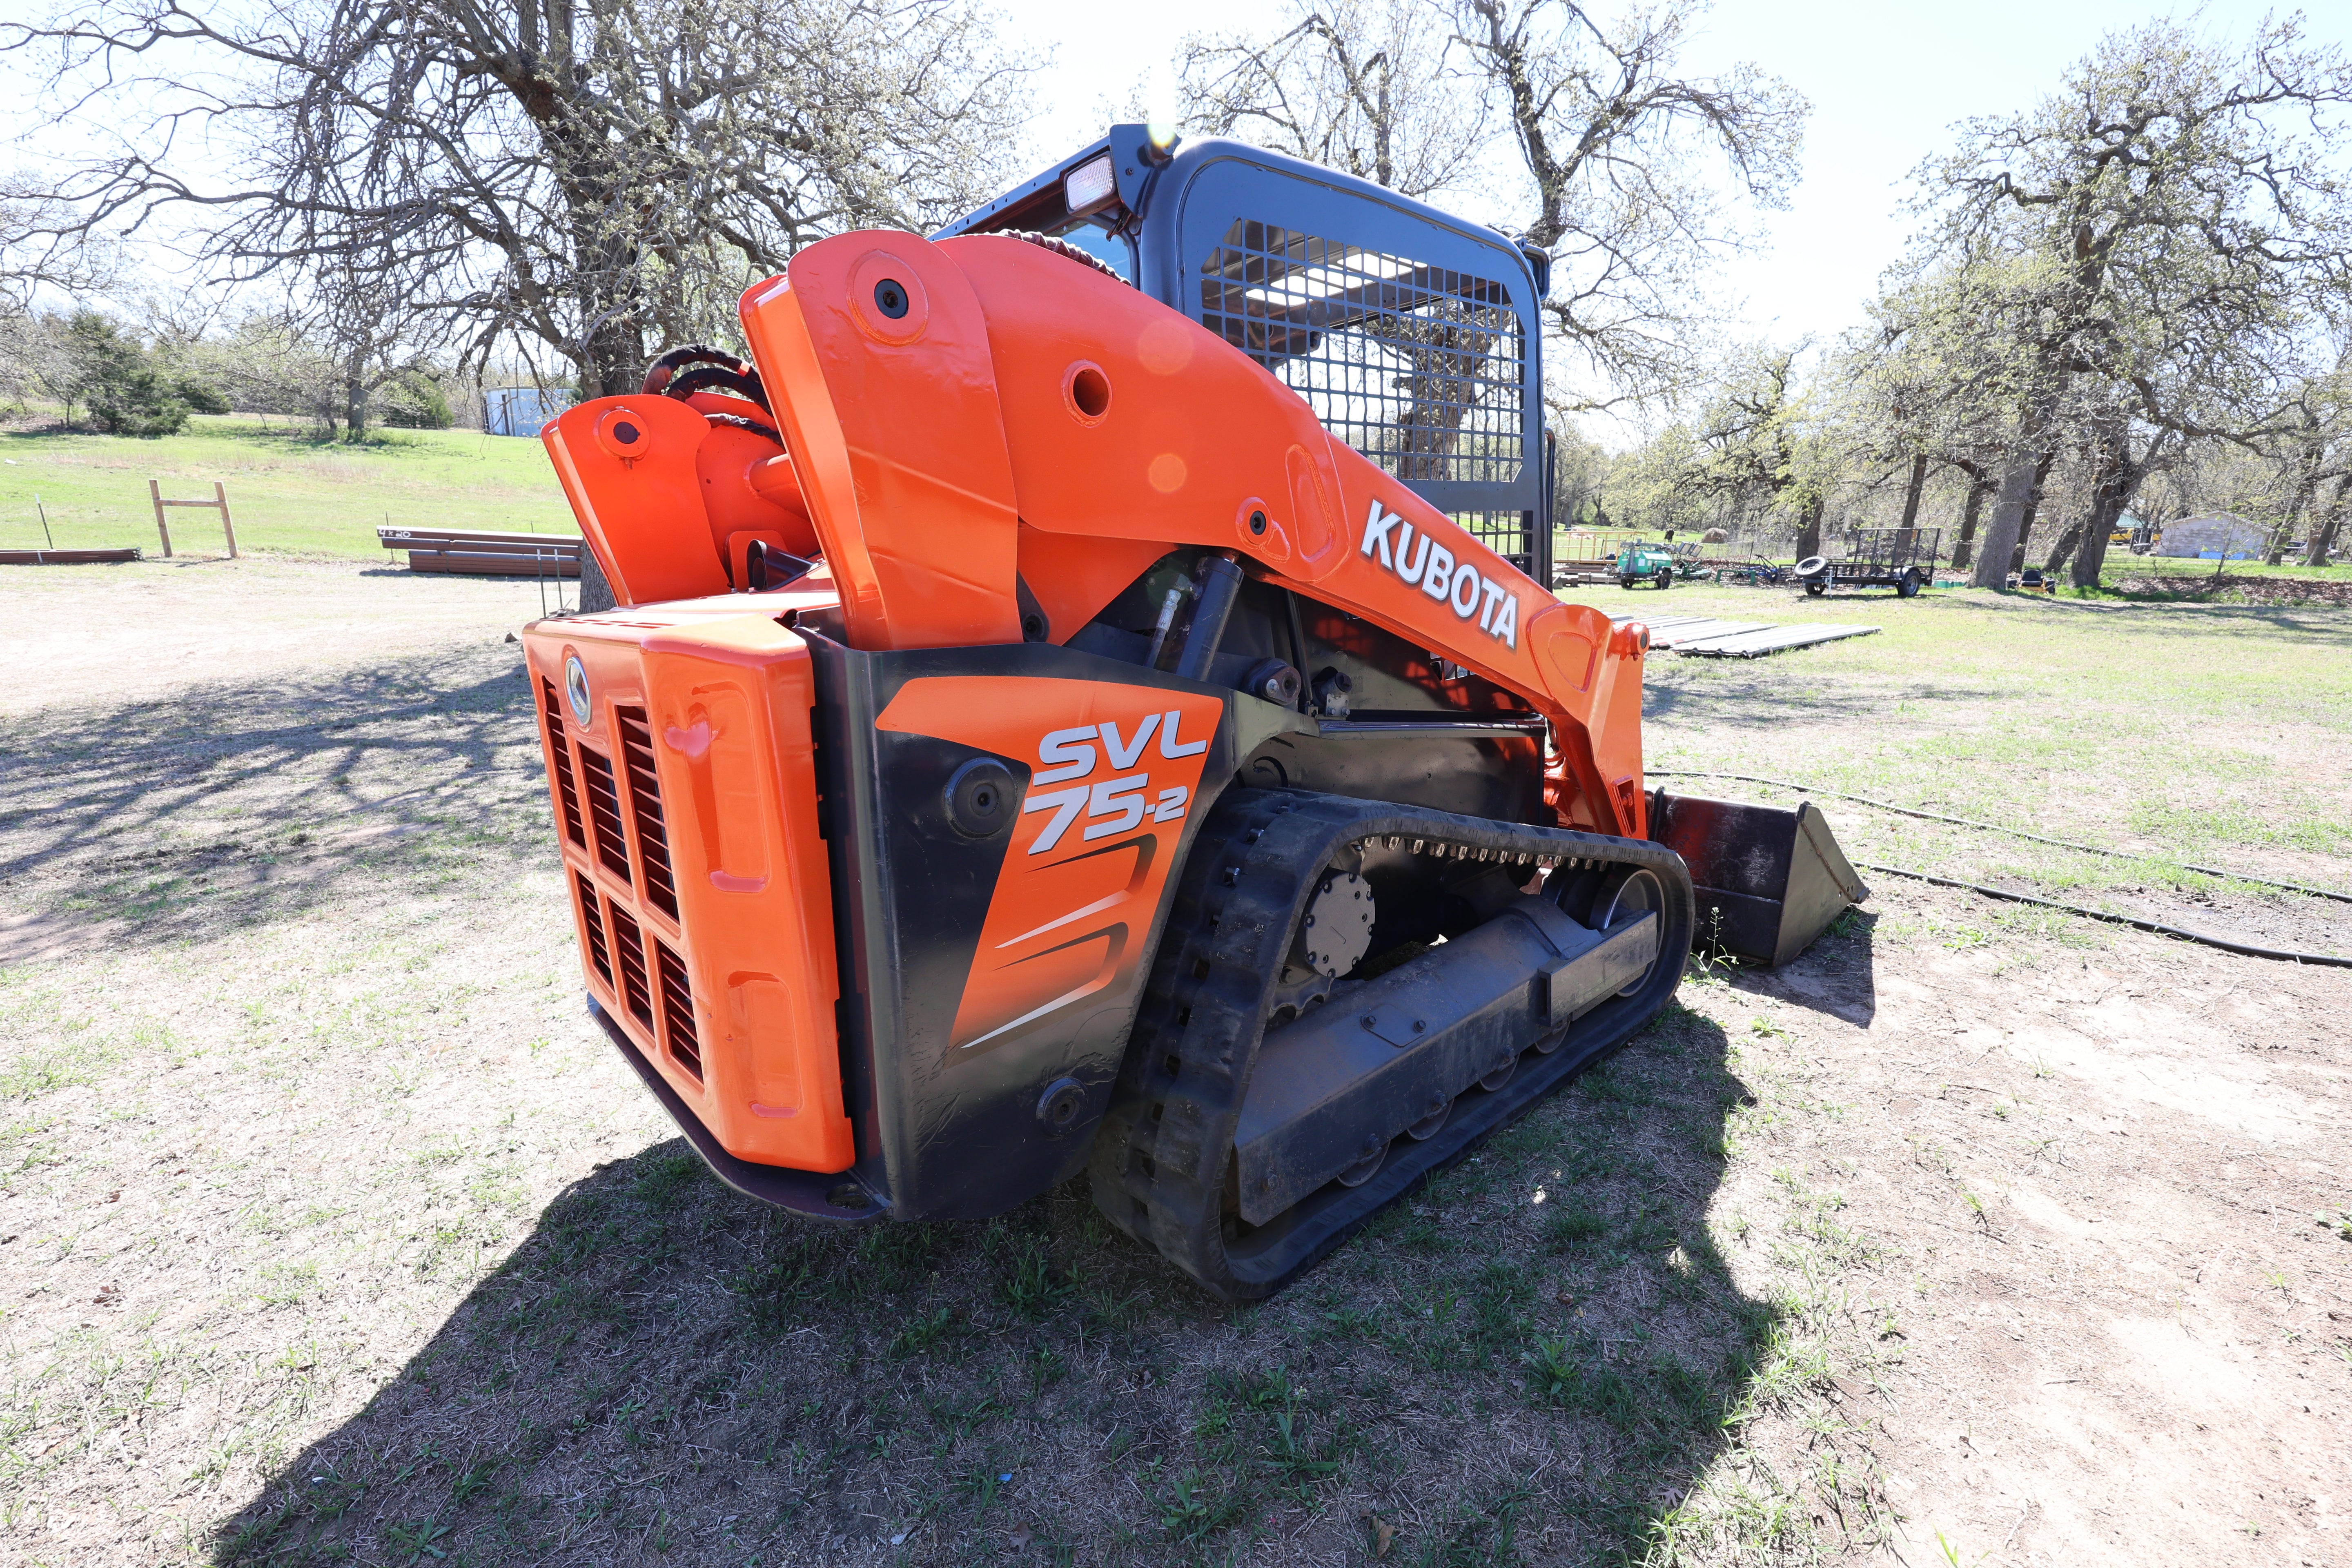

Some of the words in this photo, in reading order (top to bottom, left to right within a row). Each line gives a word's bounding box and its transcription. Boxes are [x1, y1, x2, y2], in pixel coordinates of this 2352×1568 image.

[1361, 499, 1518, 649] KUBOTA
[1033, 710, 1207, 786] SVL
[1024, 773, 1188, 855] 75-2
